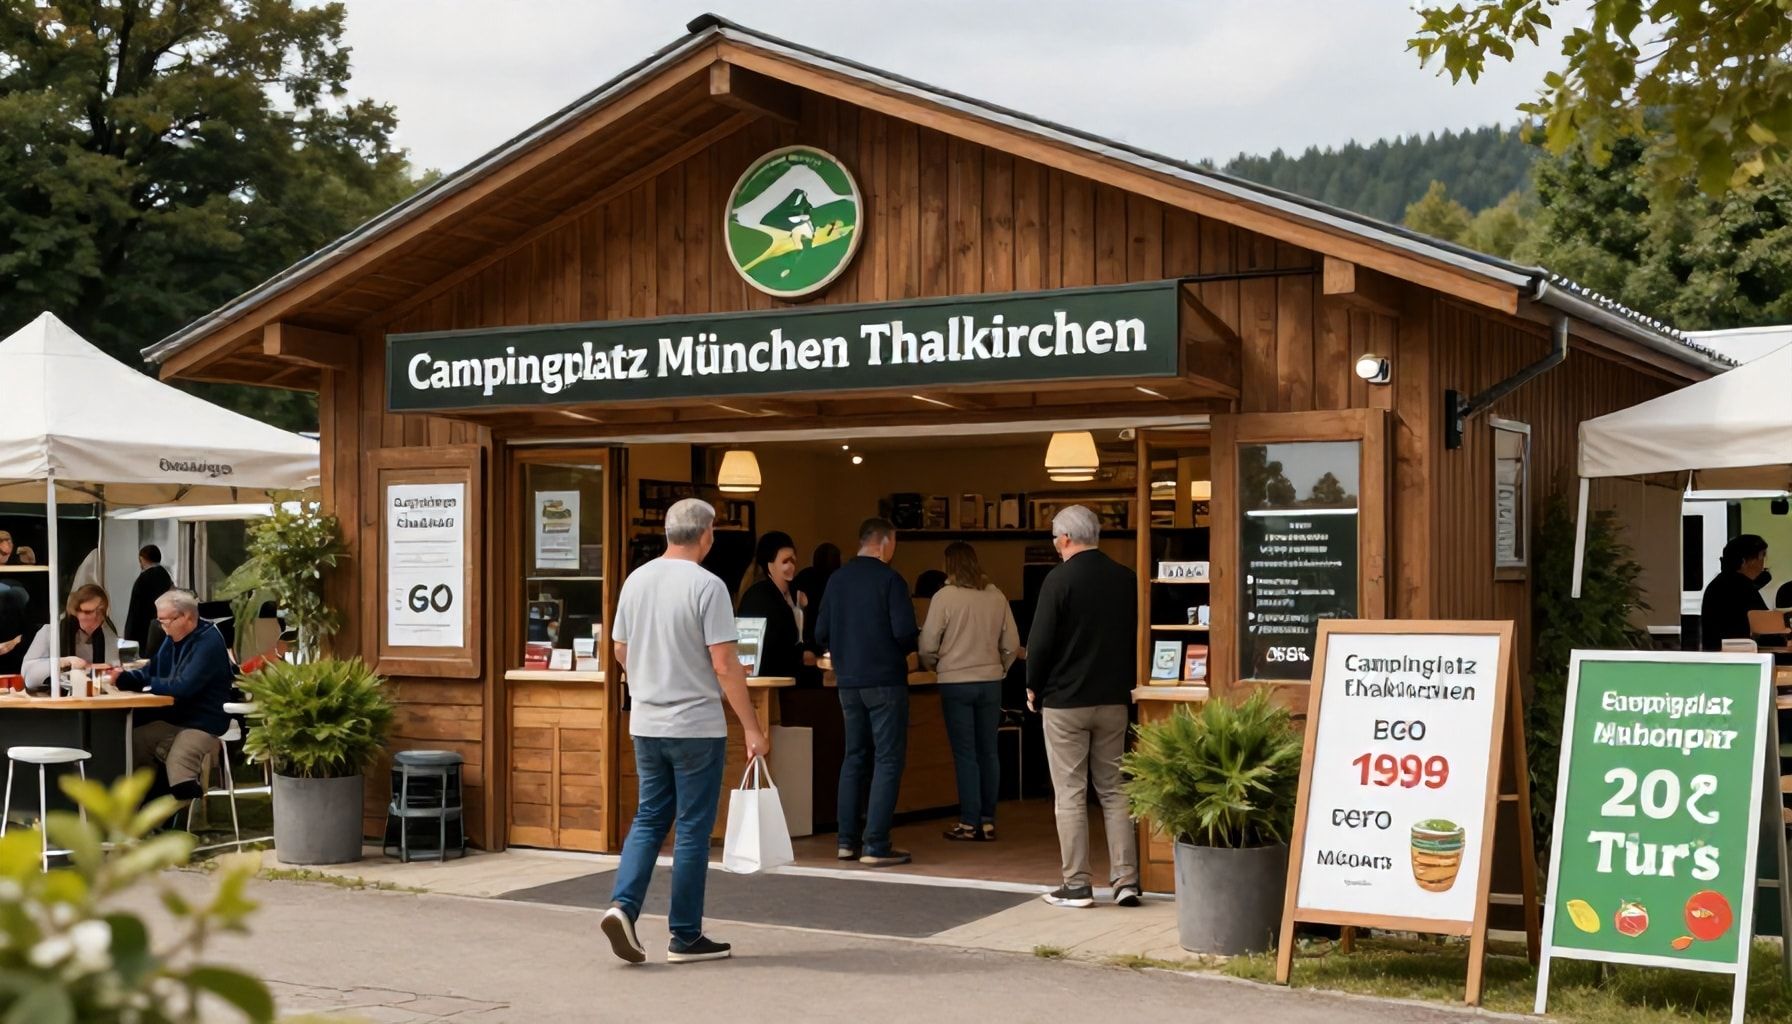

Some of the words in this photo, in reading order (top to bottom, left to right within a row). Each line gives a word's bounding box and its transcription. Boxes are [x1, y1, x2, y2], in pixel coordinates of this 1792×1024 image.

[408, 342, 649, 396] Campingplatz
[658, 328, 850, 378] München
[861, 311, 1147, 364] Thalkirchen
[1352, 753, 1450, 789] 1999
